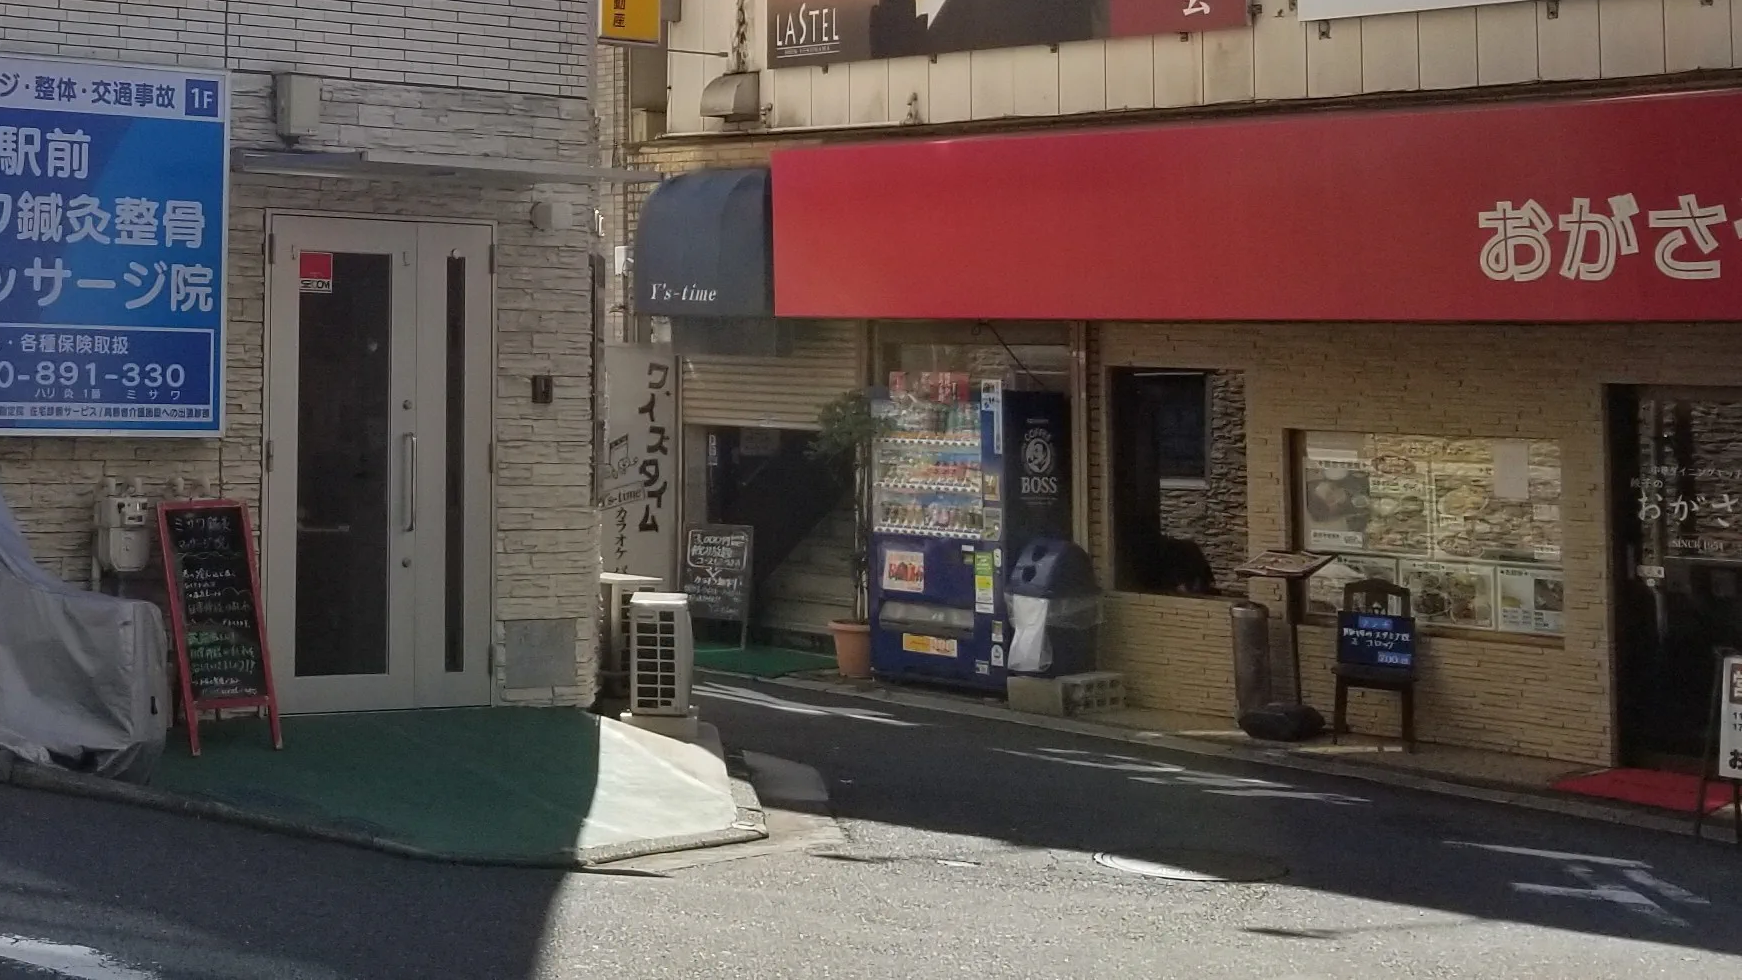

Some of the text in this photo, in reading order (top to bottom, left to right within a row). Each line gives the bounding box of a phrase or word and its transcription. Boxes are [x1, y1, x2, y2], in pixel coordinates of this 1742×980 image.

[776, 2, 839, 46] LASTEL
[190, 87, 214, 109] 1F
[1478, 192, 1742, 282] おがさ
[650, 283, 717, 302] Y's-time
[1020, 477, 1058, 494] BOSS
[614, 506, 628, 560] カラオケ
